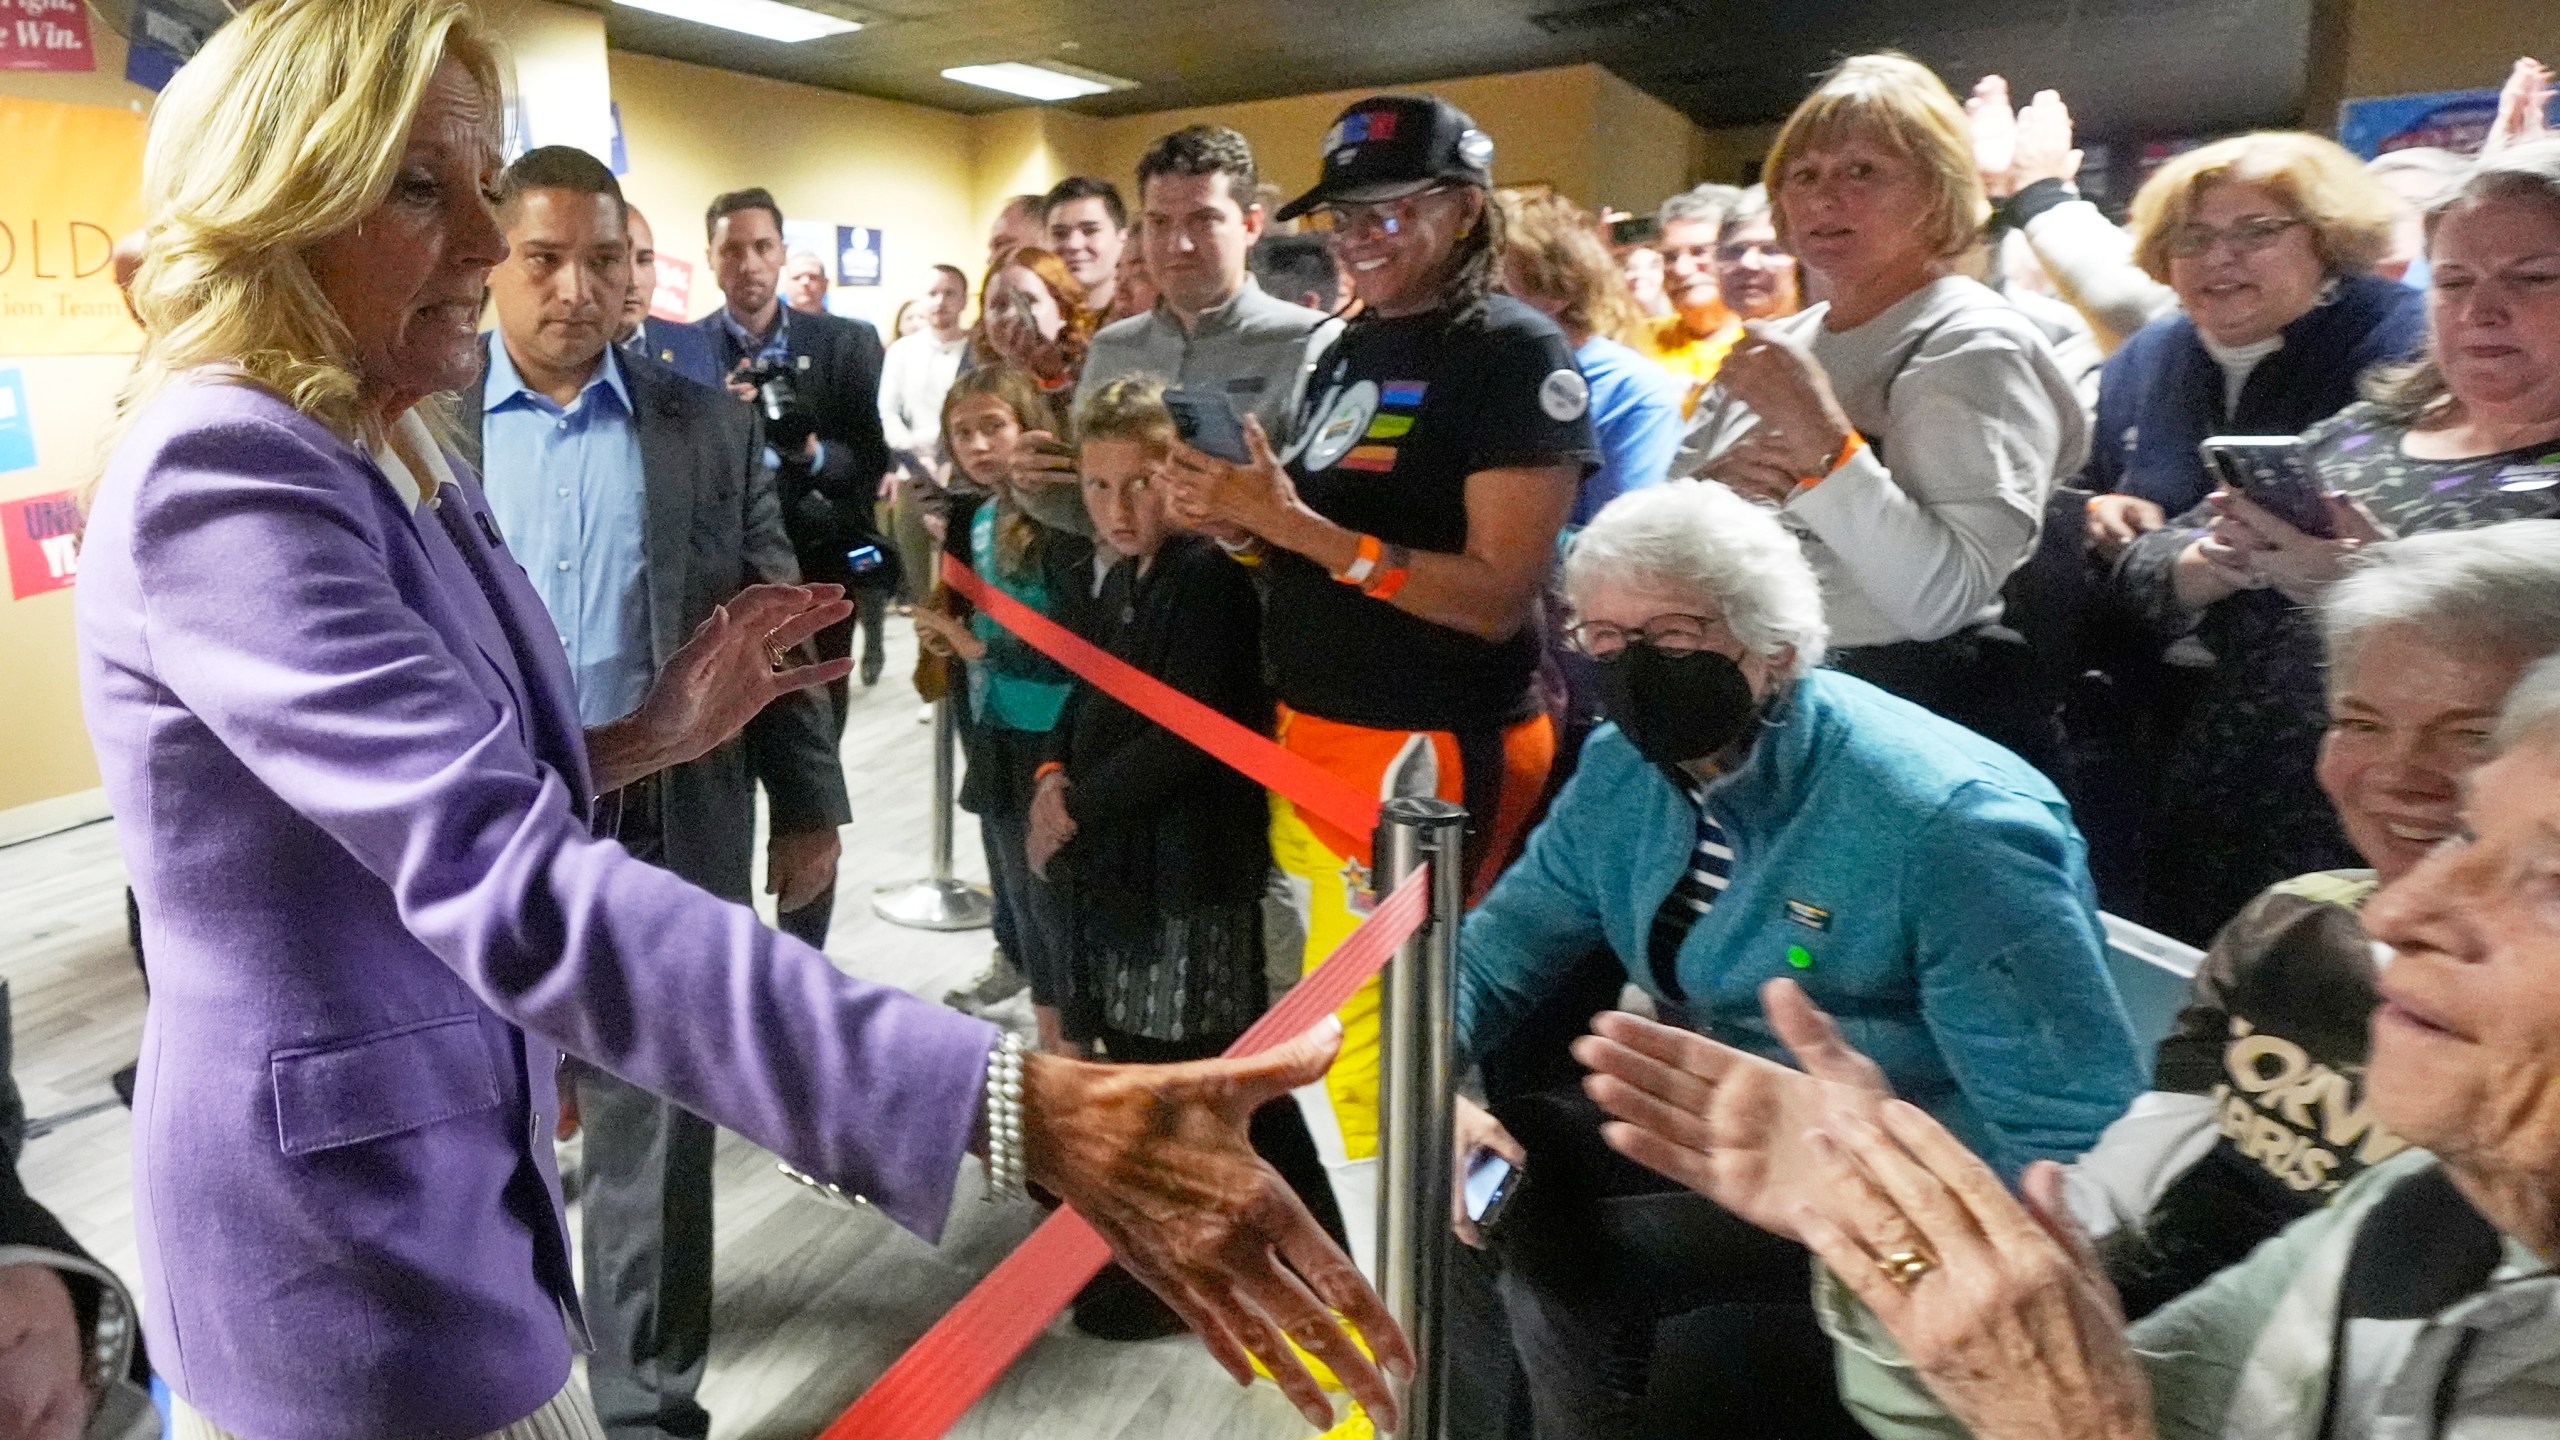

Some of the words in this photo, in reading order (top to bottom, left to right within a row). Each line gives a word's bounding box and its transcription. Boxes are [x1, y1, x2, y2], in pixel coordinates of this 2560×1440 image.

[16, 20, 83, 49] Win.
[0, 219, 113, 278] LD
[2, 291, 43, 316] ion
[51, 291, 122, 316] Team
